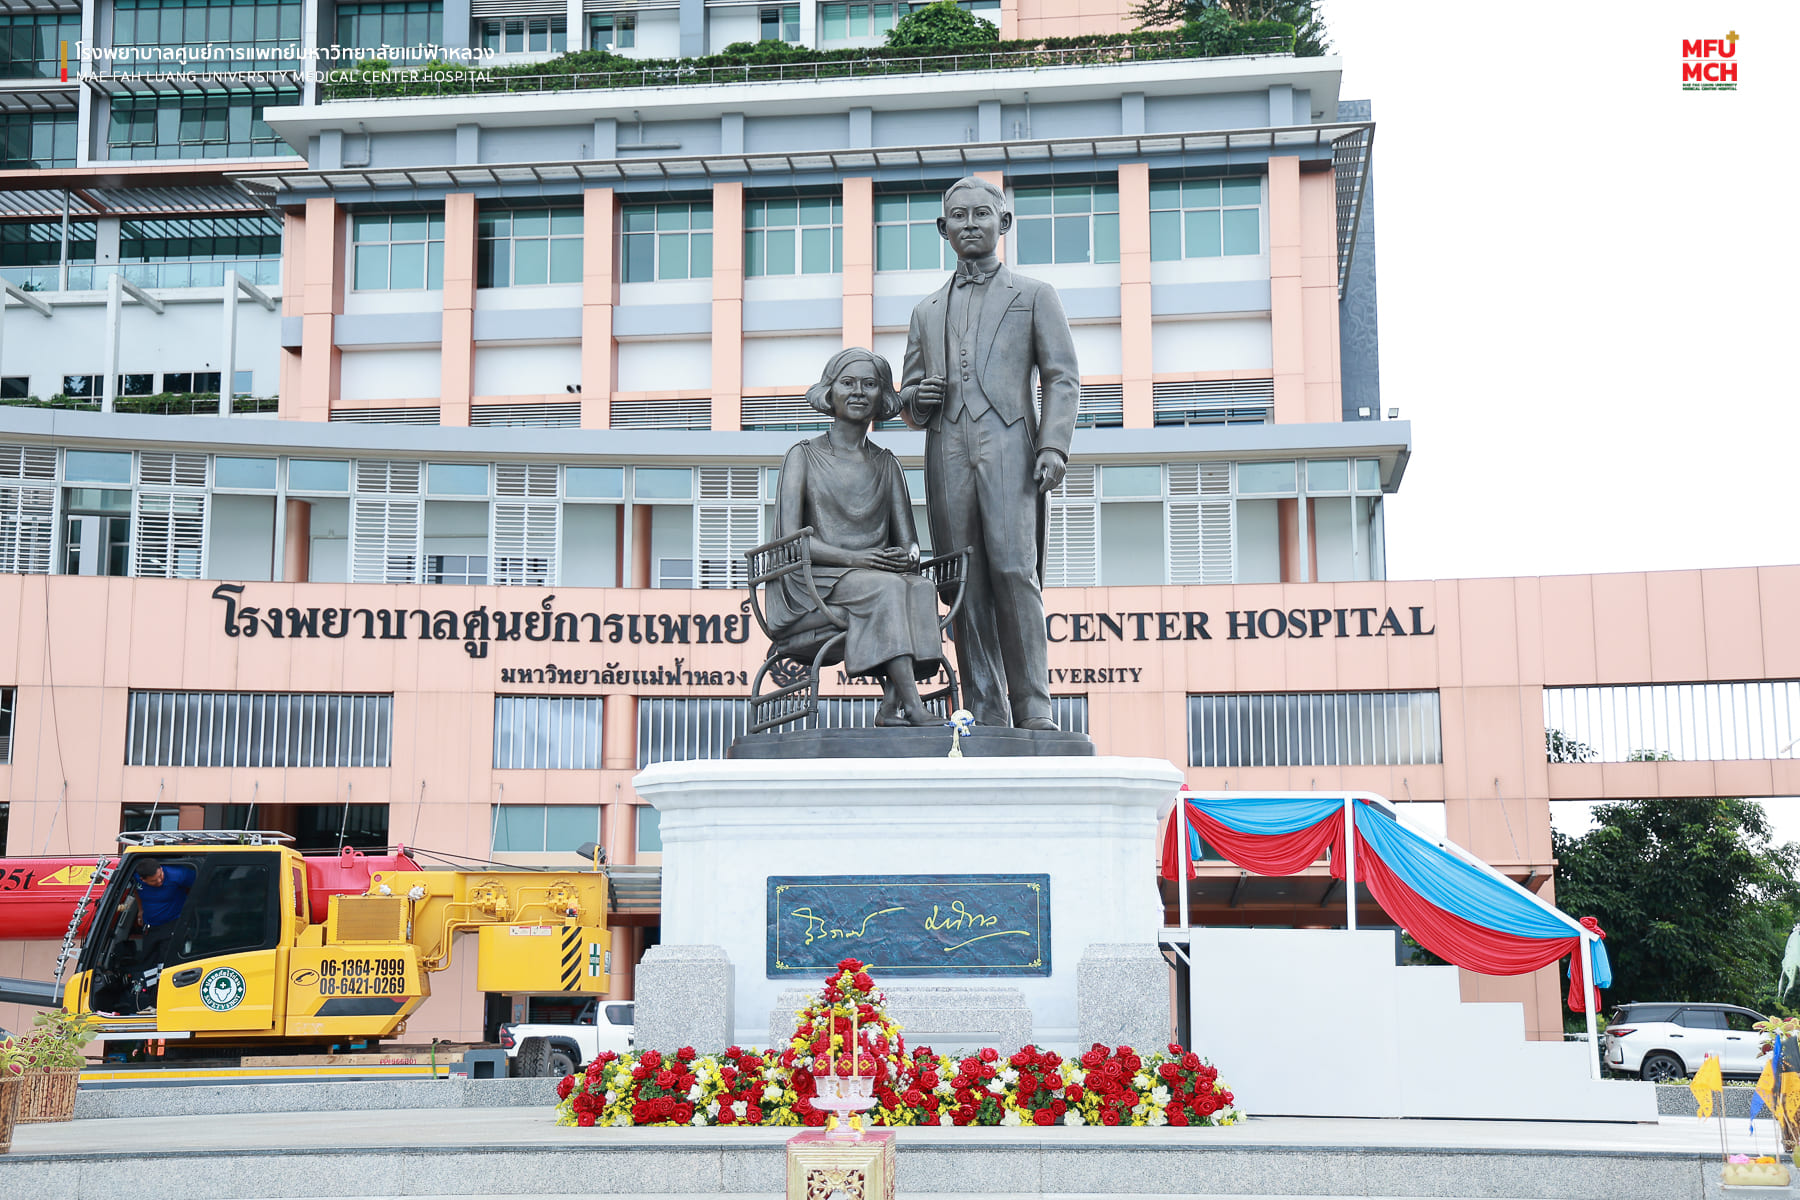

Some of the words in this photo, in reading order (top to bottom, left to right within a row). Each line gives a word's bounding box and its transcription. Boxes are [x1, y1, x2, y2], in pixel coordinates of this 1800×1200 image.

[212, 583, 752, 658] โรงพยาบาลศูนย์การแพทย์
[1047, 611, 1212, 643] CENTER
[1226, 606, 1436, 640] HOSPITAL
[501, 657, 748, 686] มหาวิทยาลัยแม่ฟ้าหลวง
[1048, 667, 1143, 684] IVERSITY
[320, 958, 405, 977] 06-1364-7999
[319, 977, 405, 995] 08-6421-0269
